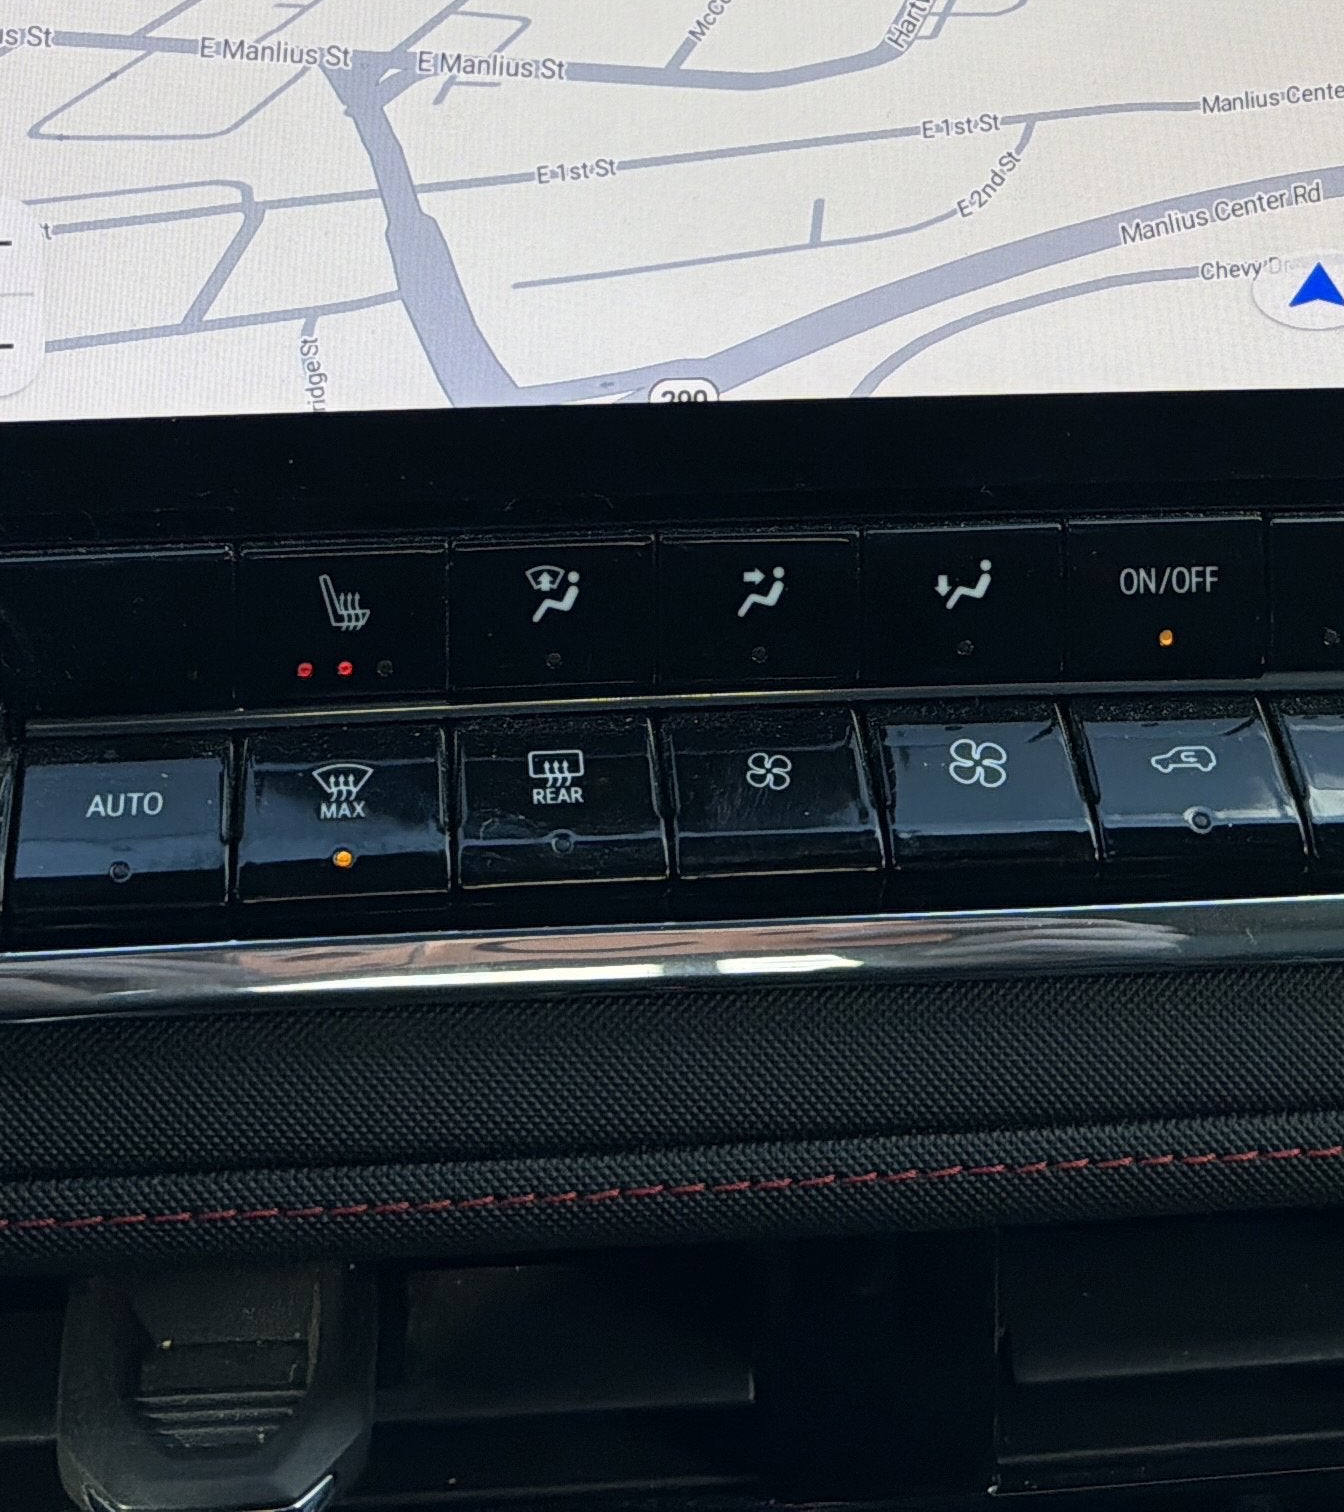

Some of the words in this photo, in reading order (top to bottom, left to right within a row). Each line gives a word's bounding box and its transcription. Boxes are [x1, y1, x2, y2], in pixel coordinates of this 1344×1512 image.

[26, 25, 52, 48] St
[200, 37, 216, 58] E
[222, 39, 320, 67] Manlius
[324, 44, 351, 68] St
[418, 50, 434, 72] E
[439, 51, 533, 78] Manlius
[540, 57, 566, 80] St
[1201, 90, 1281, 114] Manlius
[921, 119, 936, 138] E
[943, 117, 973, 136] 1st
[979, 113, 1000, 133] St
[536, 165, 550, 184] E
[555, 161, 589, 181] 1st
[592, 158, 616, 178] St
[956, 197, 973, 218] E
[970, 169, 1007, 207] 2nd
[998, 150, 1022, 175] St
[1120, 209, 1209, 245] Manlius
[1213, 191, 1288, 223] Center
[1292, 182, 1322, 205] Rd
[1200, 259, 1263, 281] Chevy
[299, 336, 319, 358] St
[1119, 564, 1219, 595] ON/OFF
[85, 791, 164, 818] AUTO
[531, 786, 584, 806] REAR
[319, 800, 367, 821] MAX
